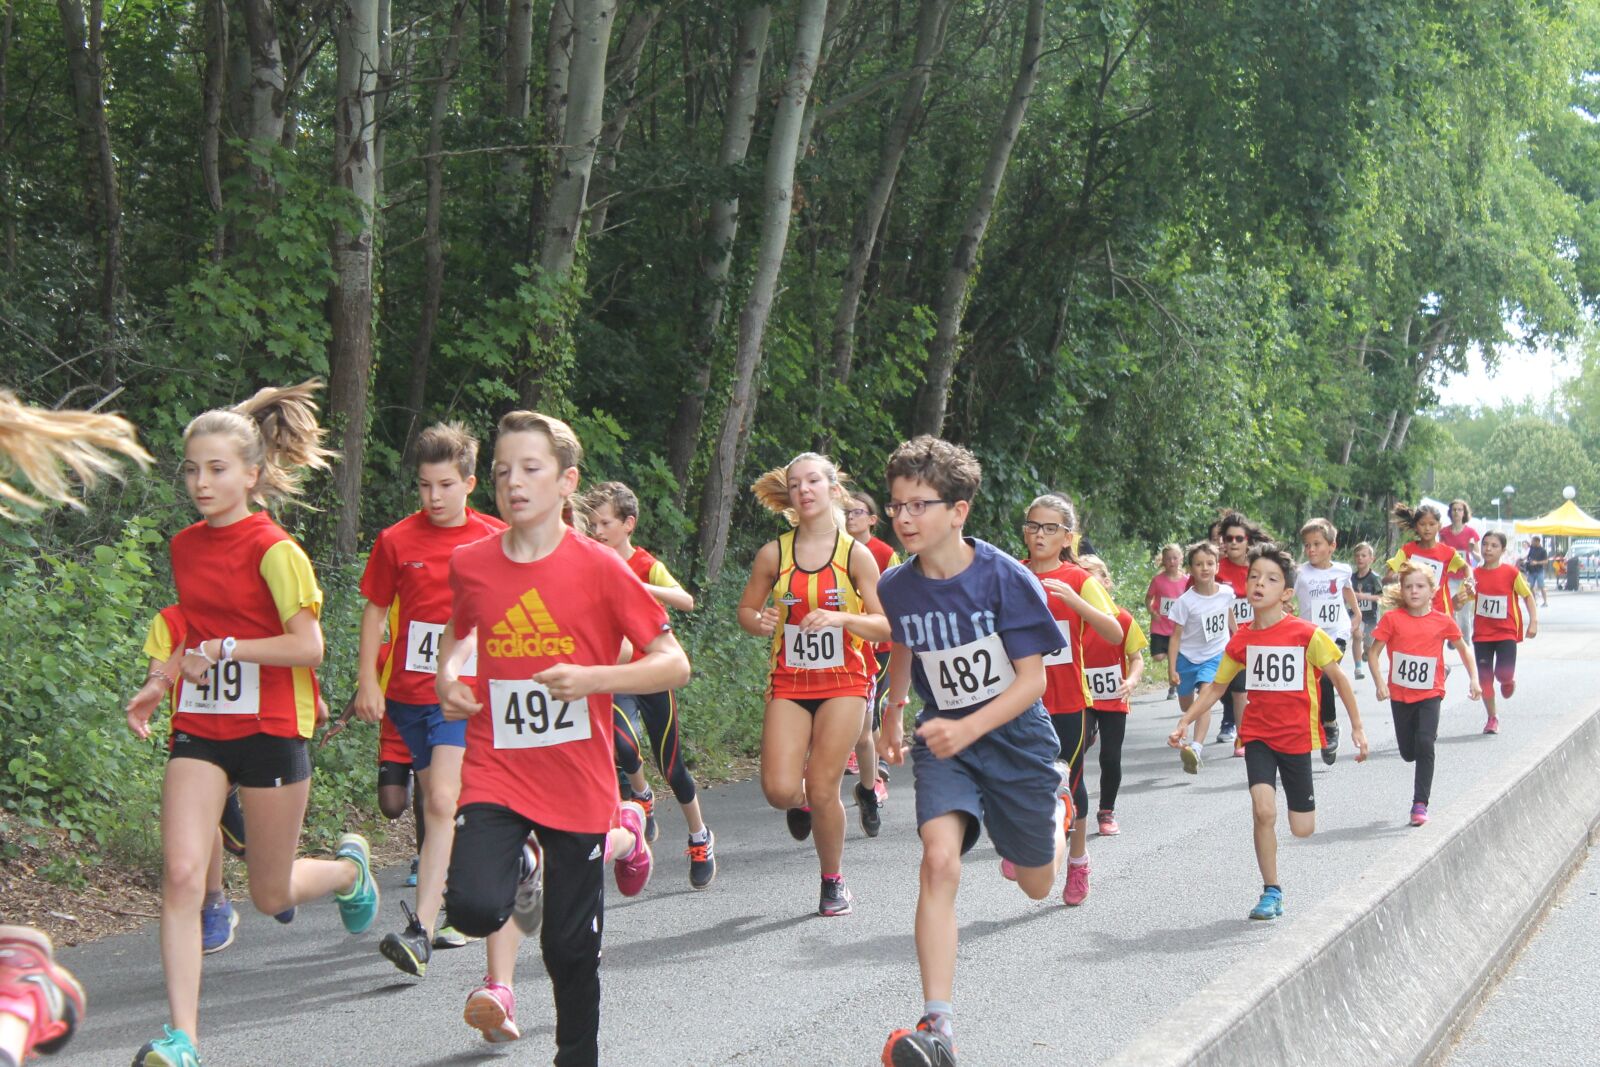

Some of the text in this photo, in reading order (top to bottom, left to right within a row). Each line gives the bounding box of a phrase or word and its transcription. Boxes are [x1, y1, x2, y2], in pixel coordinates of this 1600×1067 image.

[1318, 604, 1341, 623] 487
[1482, 600, 1500, 614] 471
[1206, 613, 1225, 635] 483
[486, 632, 576, 657] adidas
[793, 631, 835, 662] 450
[939, 649, 1001, 697] 482
[1253, 653, 1295, 683] 466
[1398, 660, 1429, 683] 488
[505, 690, 574, 735] 492
